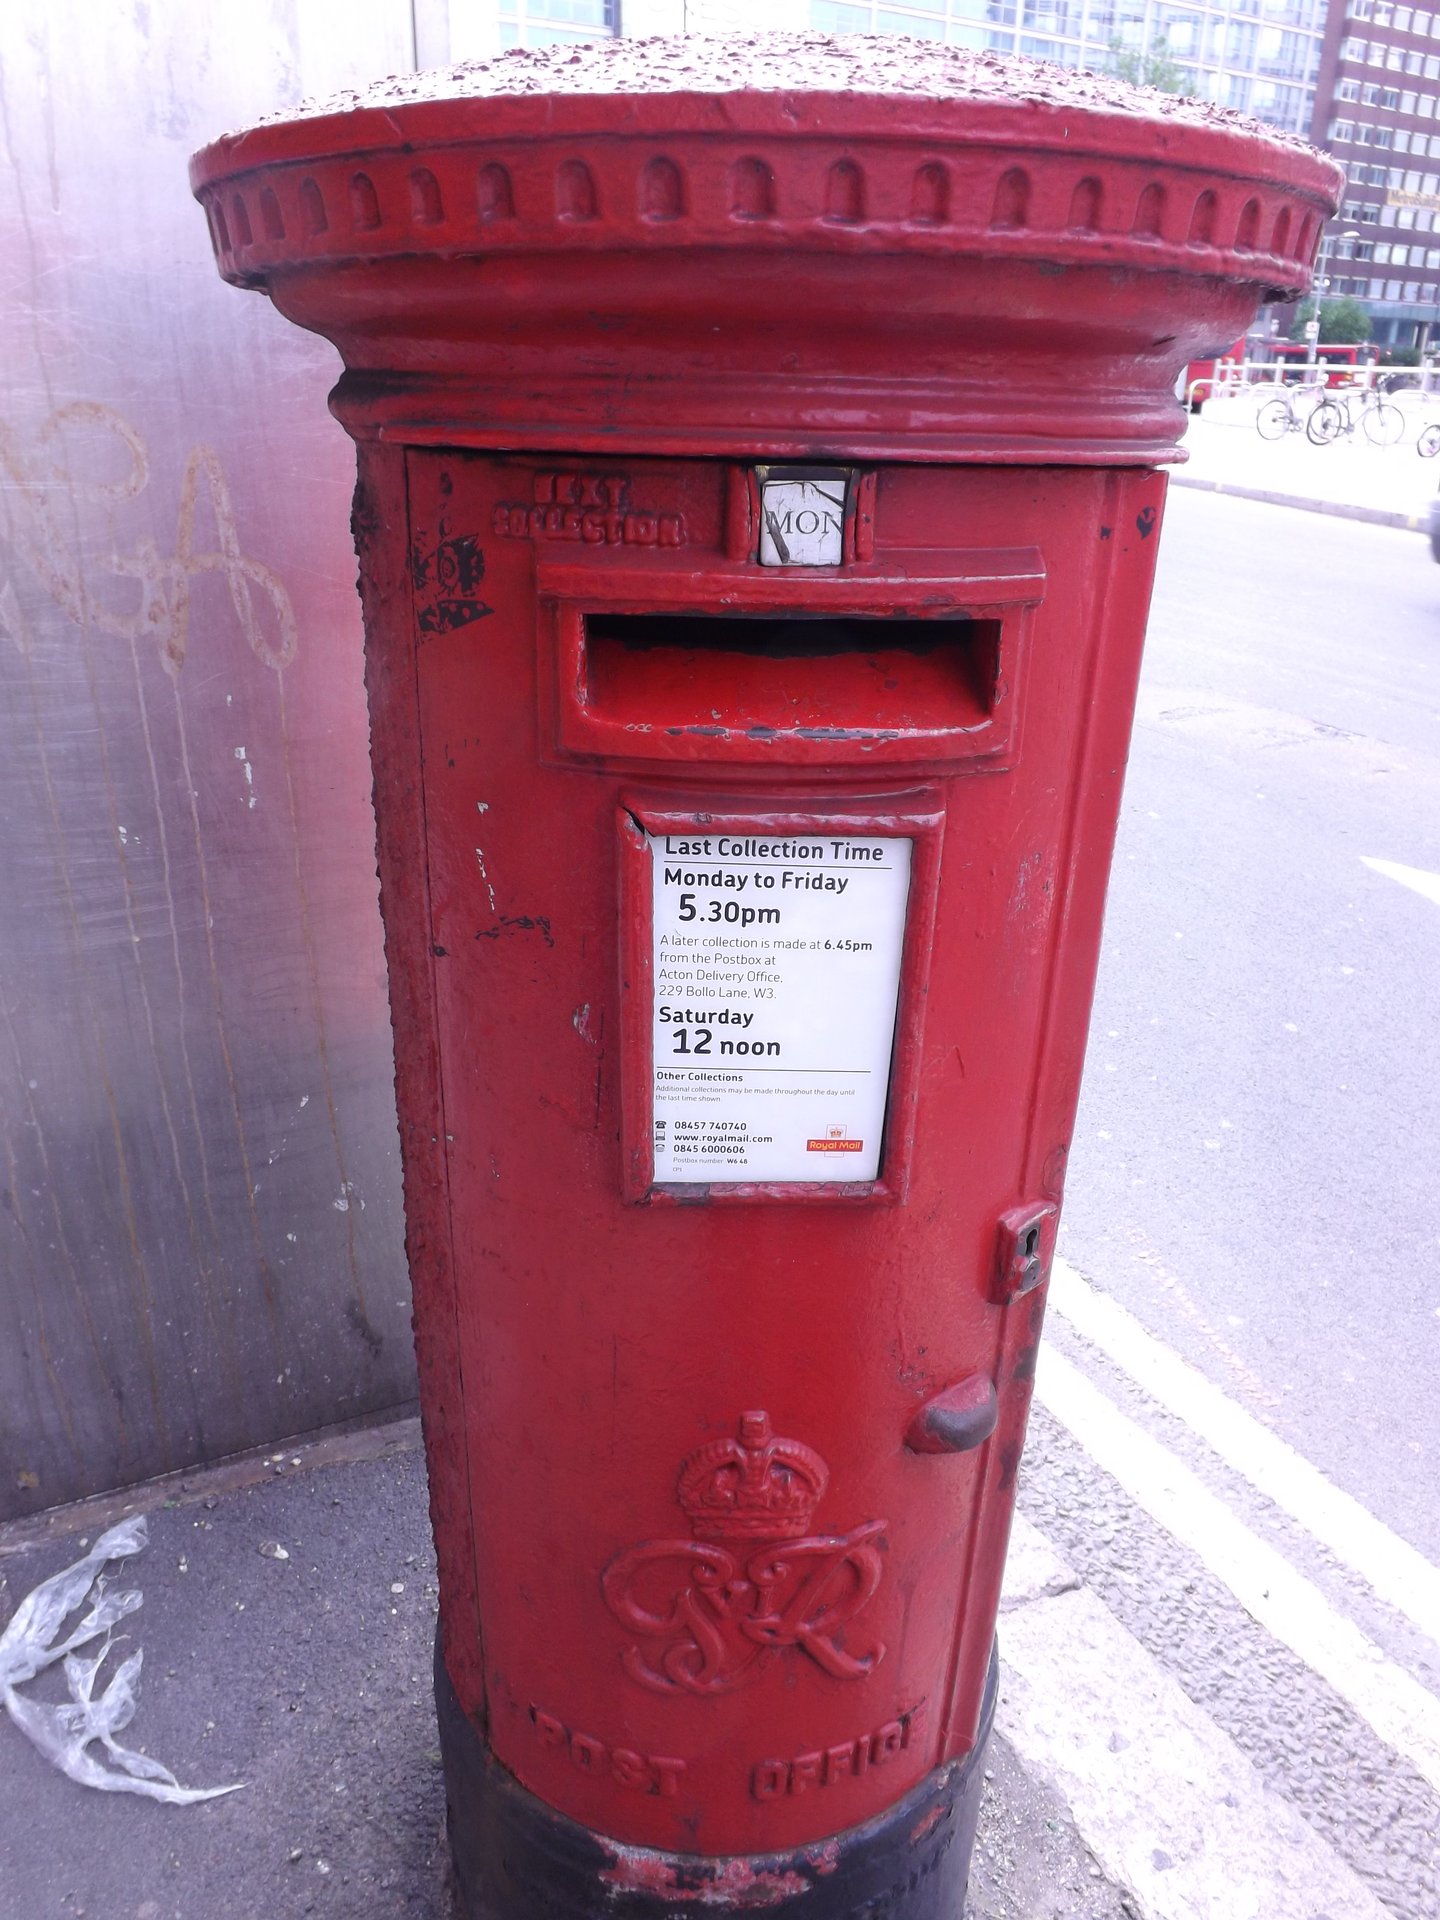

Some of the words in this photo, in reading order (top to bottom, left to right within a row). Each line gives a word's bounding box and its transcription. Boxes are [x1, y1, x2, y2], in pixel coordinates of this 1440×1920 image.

[664, 837, 712, 856] Last
[717, 837, 825, 859] Collection
[830, 841, 885, 861] Time
[664, 868, 749, 892] Monday
[754, 872, 776, 889] to
[781, 871, 850, 894] Friday
[678, 893, 781, 928] 5.30pm
[660, 934, 669, 946] A
[671, 934, 700, 947] later
[702, 936, 759, 949] collection
[761, 936, 771, 949] is
[773, 939, 808, 951] made
[809, 940, 822, 951] at
[824, 940, 873, 953] 6.45pm
[660, 952, 689, 964] from
[692, 953, 711, 965] the
[714, 954, 762, 966] Postbox
[764, 955, 777, 967] at
[659, 969, 693, 981] Acton
[696, 970, 745, 984] Delivery
[658, 984, 684, 998] 229
[686, 985, 716, 999] Bollo
[659, 1006, 755, 1028] Saturday
[672, 1028, 713, 1055] 12
[719, 1040, 782, 1057] noon
[656, 1071, 686, 1081] Other
[688, 1072, 744, 1083] Collections
[655, 1084, 691, 1093] Additional
[691, 1085, 727, 1094] collections
[728, 1087, 743, 1096] may
[744, 1087, 753, 1095] be
[775, 1088, 813, 1098] throughout
[814, 1089, 826, 1097] the
[826, 1089, 840, 1097] day
[840, 1089, 857, 1097] until
[655, 1094, 667, 1102] the
[668, 1094, 681, 1102] last
[674, 1121, 707, 1131] 08457
[709, 1121, 748, 1132] 740740
[674, 1133, 774, 1145] www.royalmail.com
[809, 1140, 838, 1151] Royal
[840, 1140, 862, 1151] Mail
[673, 1144, 699, 1154] 0845
[701, 1145, 746, 1155] 6000606
[673, 1156, 698, 1165] Postbox
[699, 1158, 723, 1166] number
[531, 1702, 688, 1798] POST
